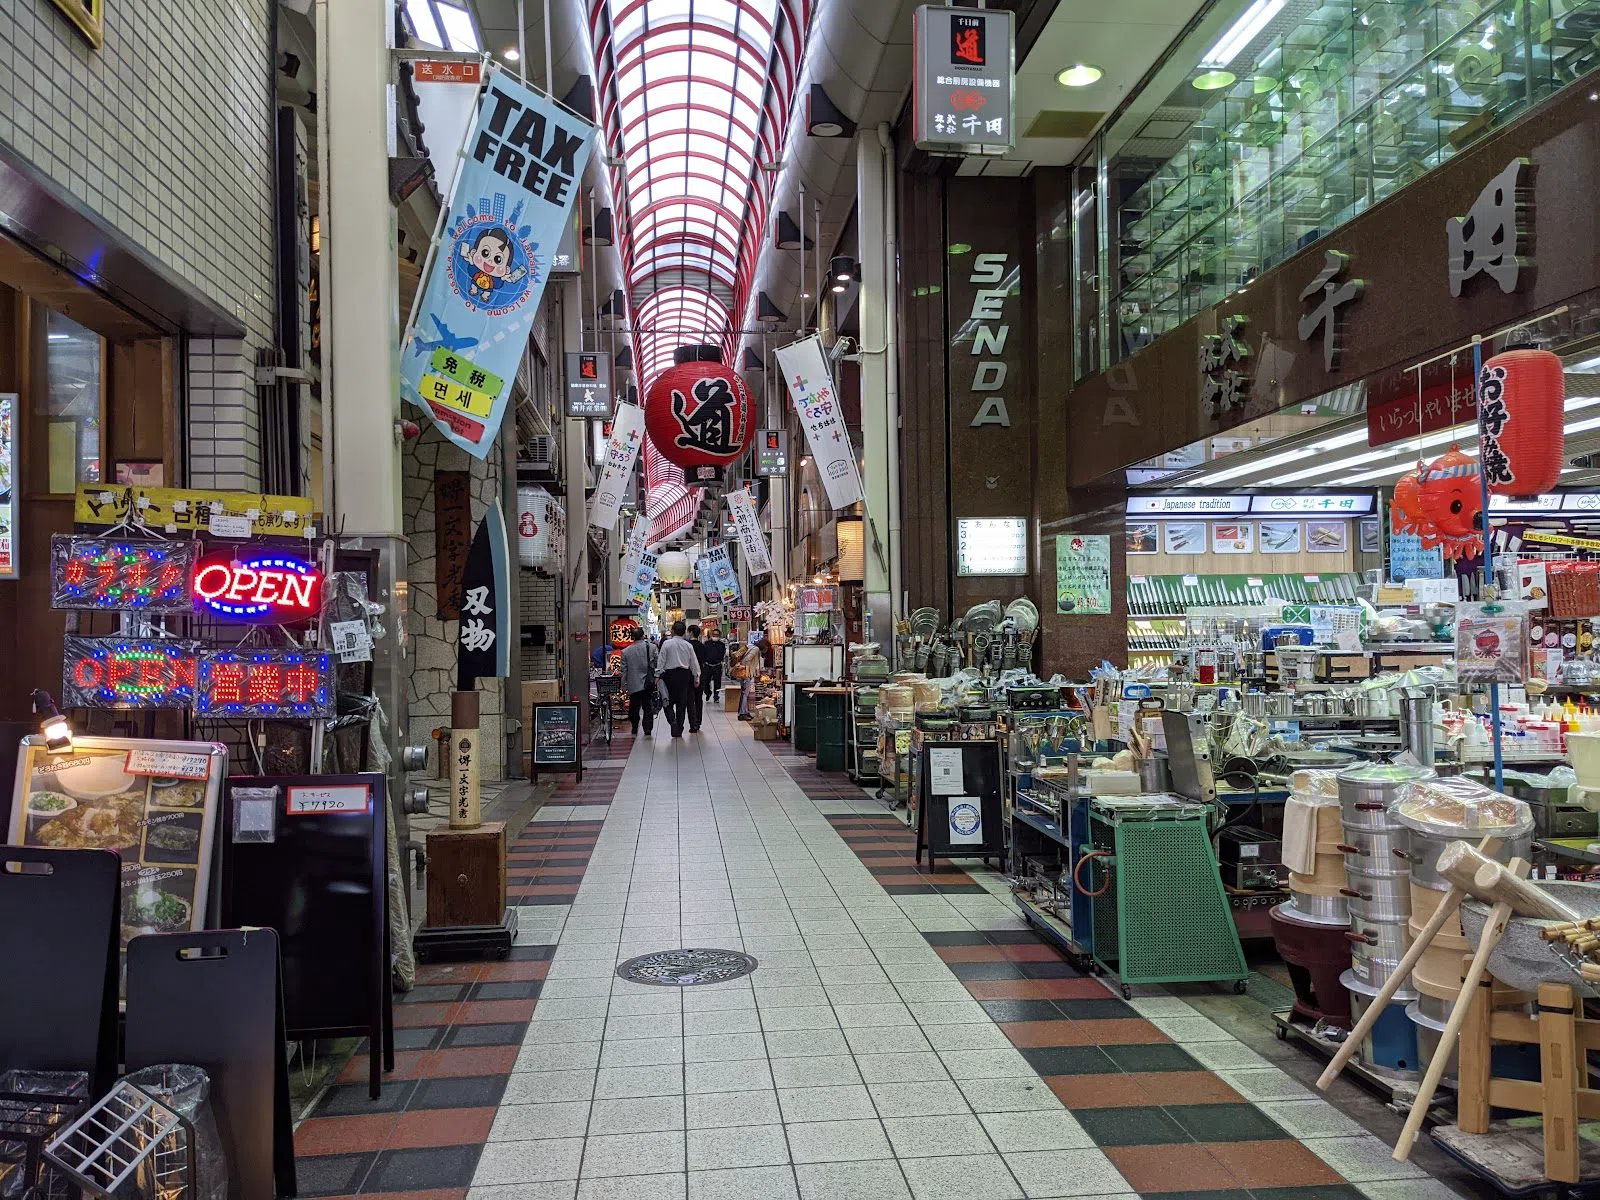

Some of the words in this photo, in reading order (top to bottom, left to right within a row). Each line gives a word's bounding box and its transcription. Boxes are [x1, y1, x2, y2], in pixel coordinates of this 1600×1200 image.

[421, 64, 474, 76] 送水口
[490, 86, 585, 178] TAX
[473, 130, 572, 208] FREE
[968, 253, 1011, 427] SENDA
[443, 356, 487, 388] 免税
[434, 381, 472, 409] 면세
[672, 377, 742, 456] 道
[610, 449, 631, 463] 守ろう
[1162, 498, 1196, 510] Japanese
[1199, 498, 1231, 509] tradition
[66, 559, 180, 589] カラオケ
[642, 552, 658, 564] TAX
[193, 563, 317, 608] OPEN
[74, 656, 195, 690] OPEN
[210, 663, 318, 703] 営業中
